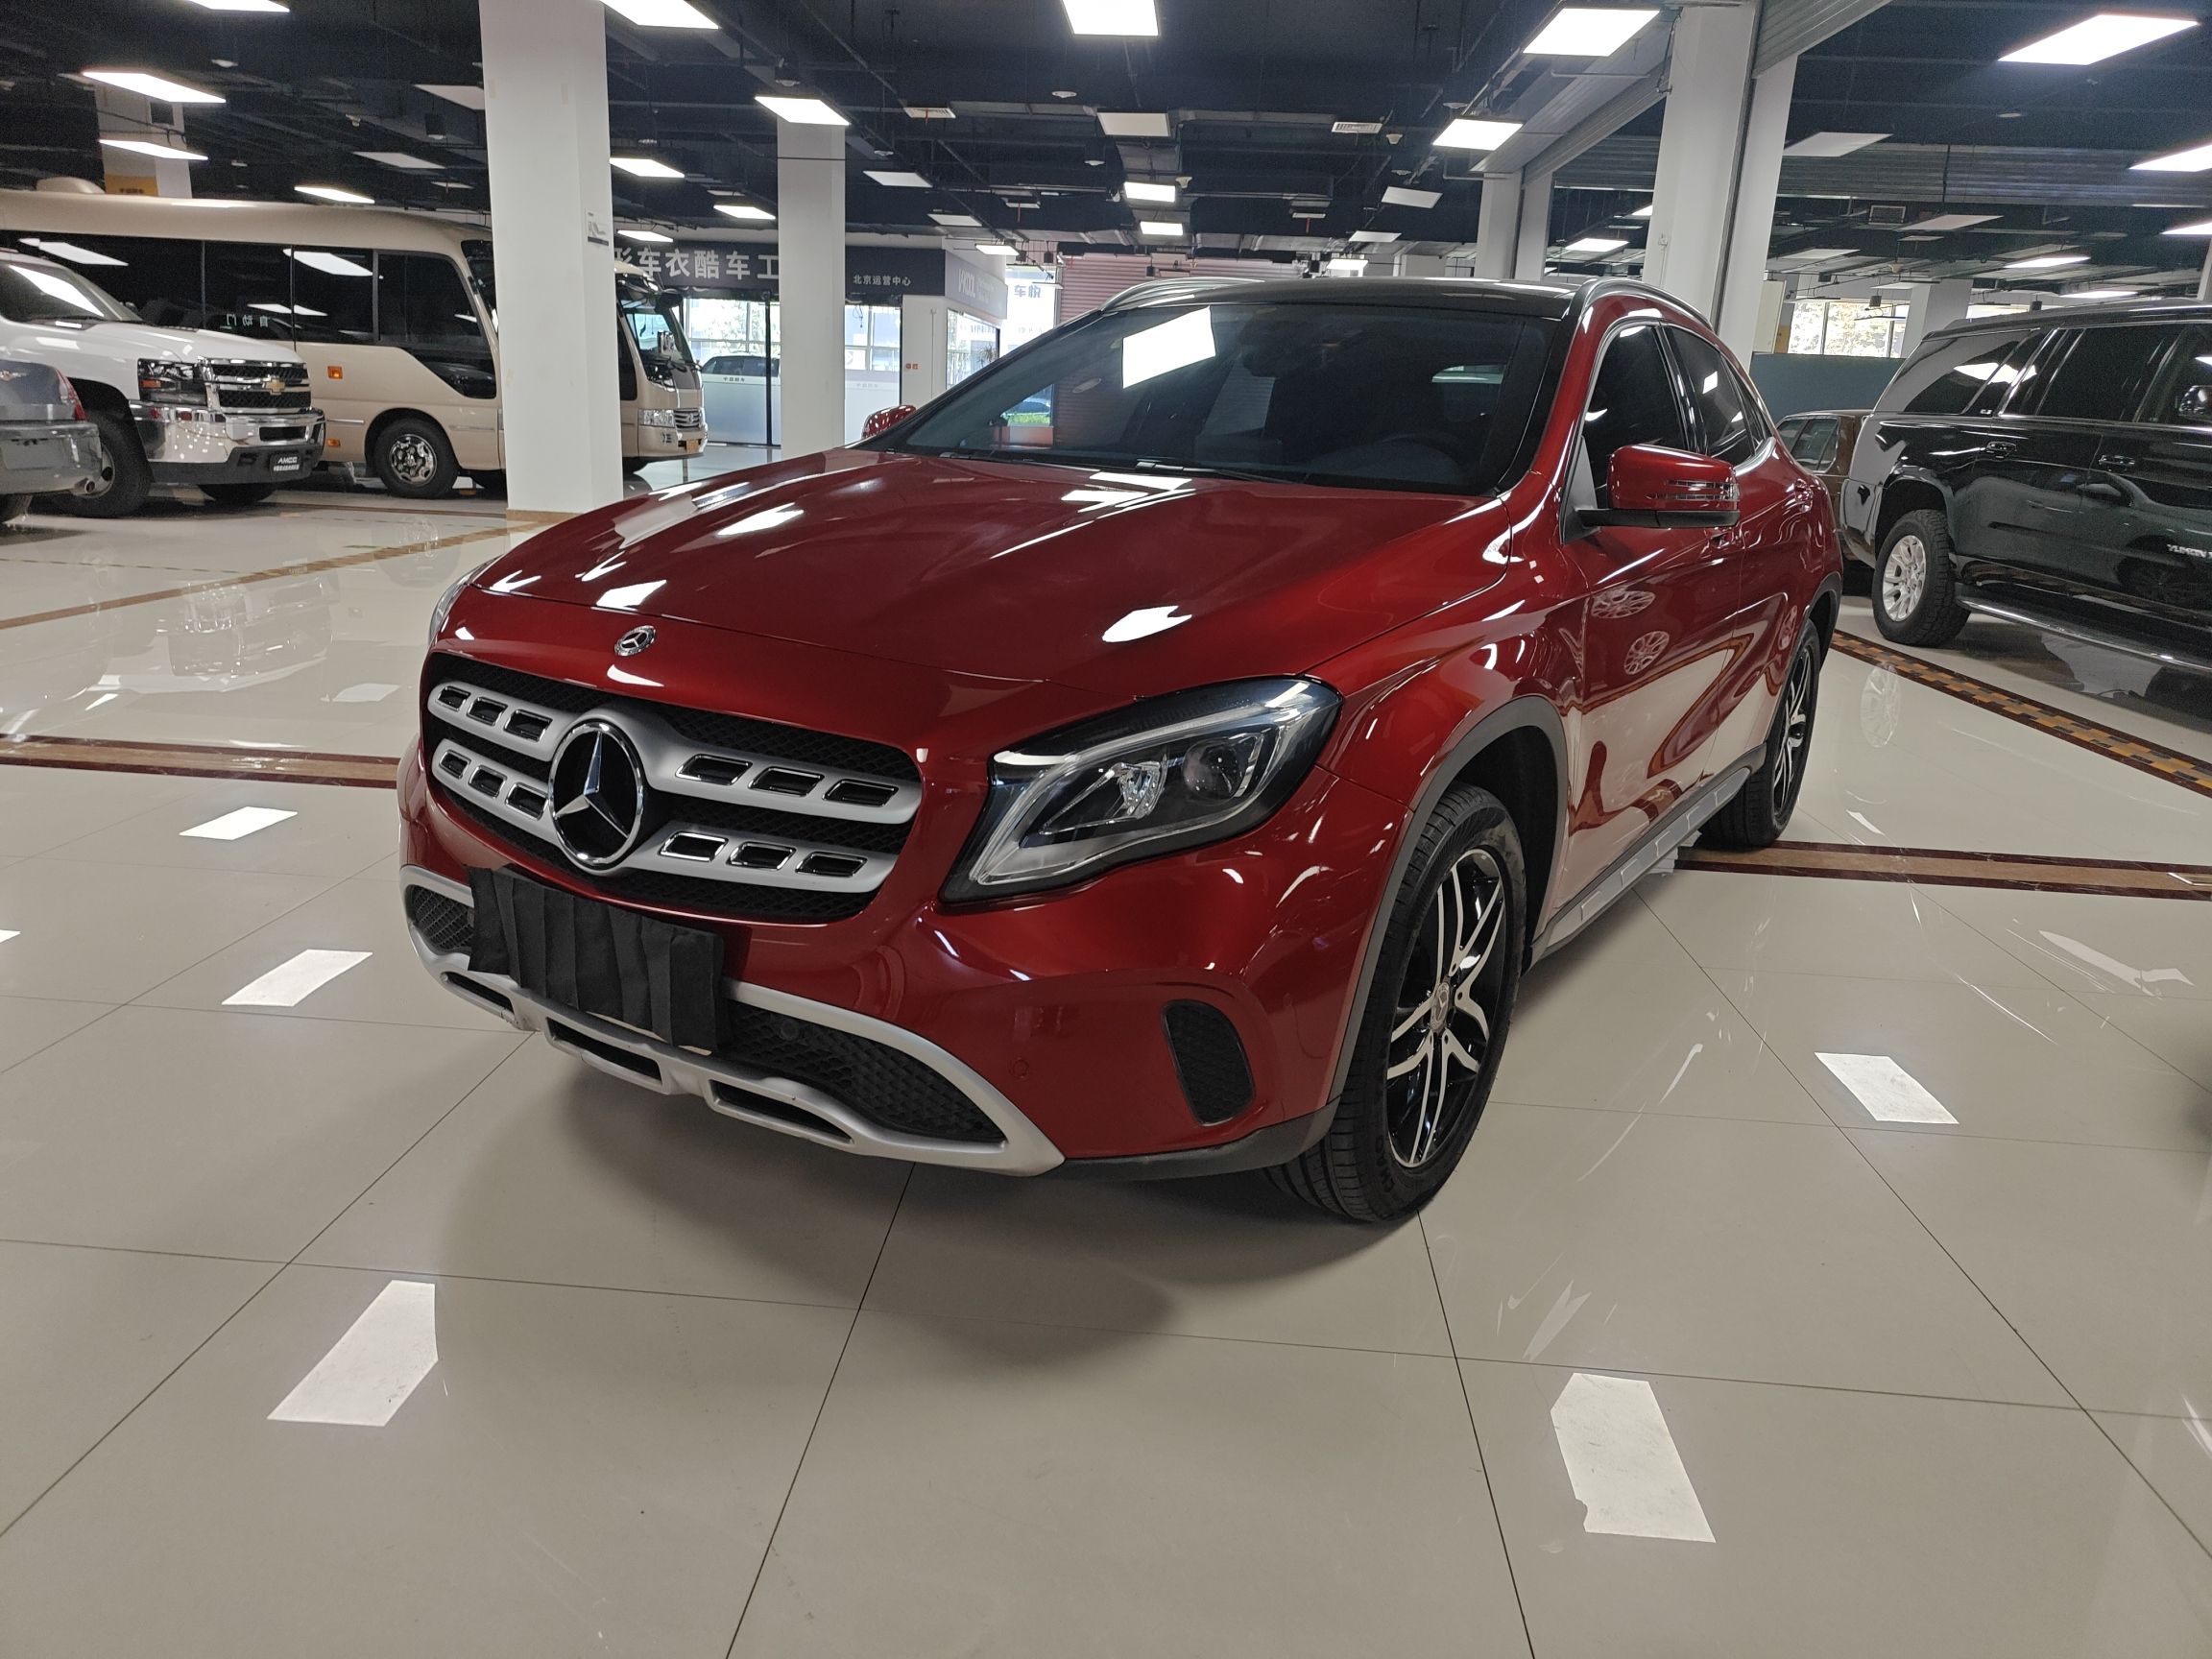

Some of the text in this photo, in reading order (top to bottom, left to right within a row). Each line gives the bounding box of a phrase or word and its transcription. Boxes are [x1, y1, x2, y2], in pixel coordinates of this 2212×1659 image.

[854, 274, 911, 287] 北京运营中心
